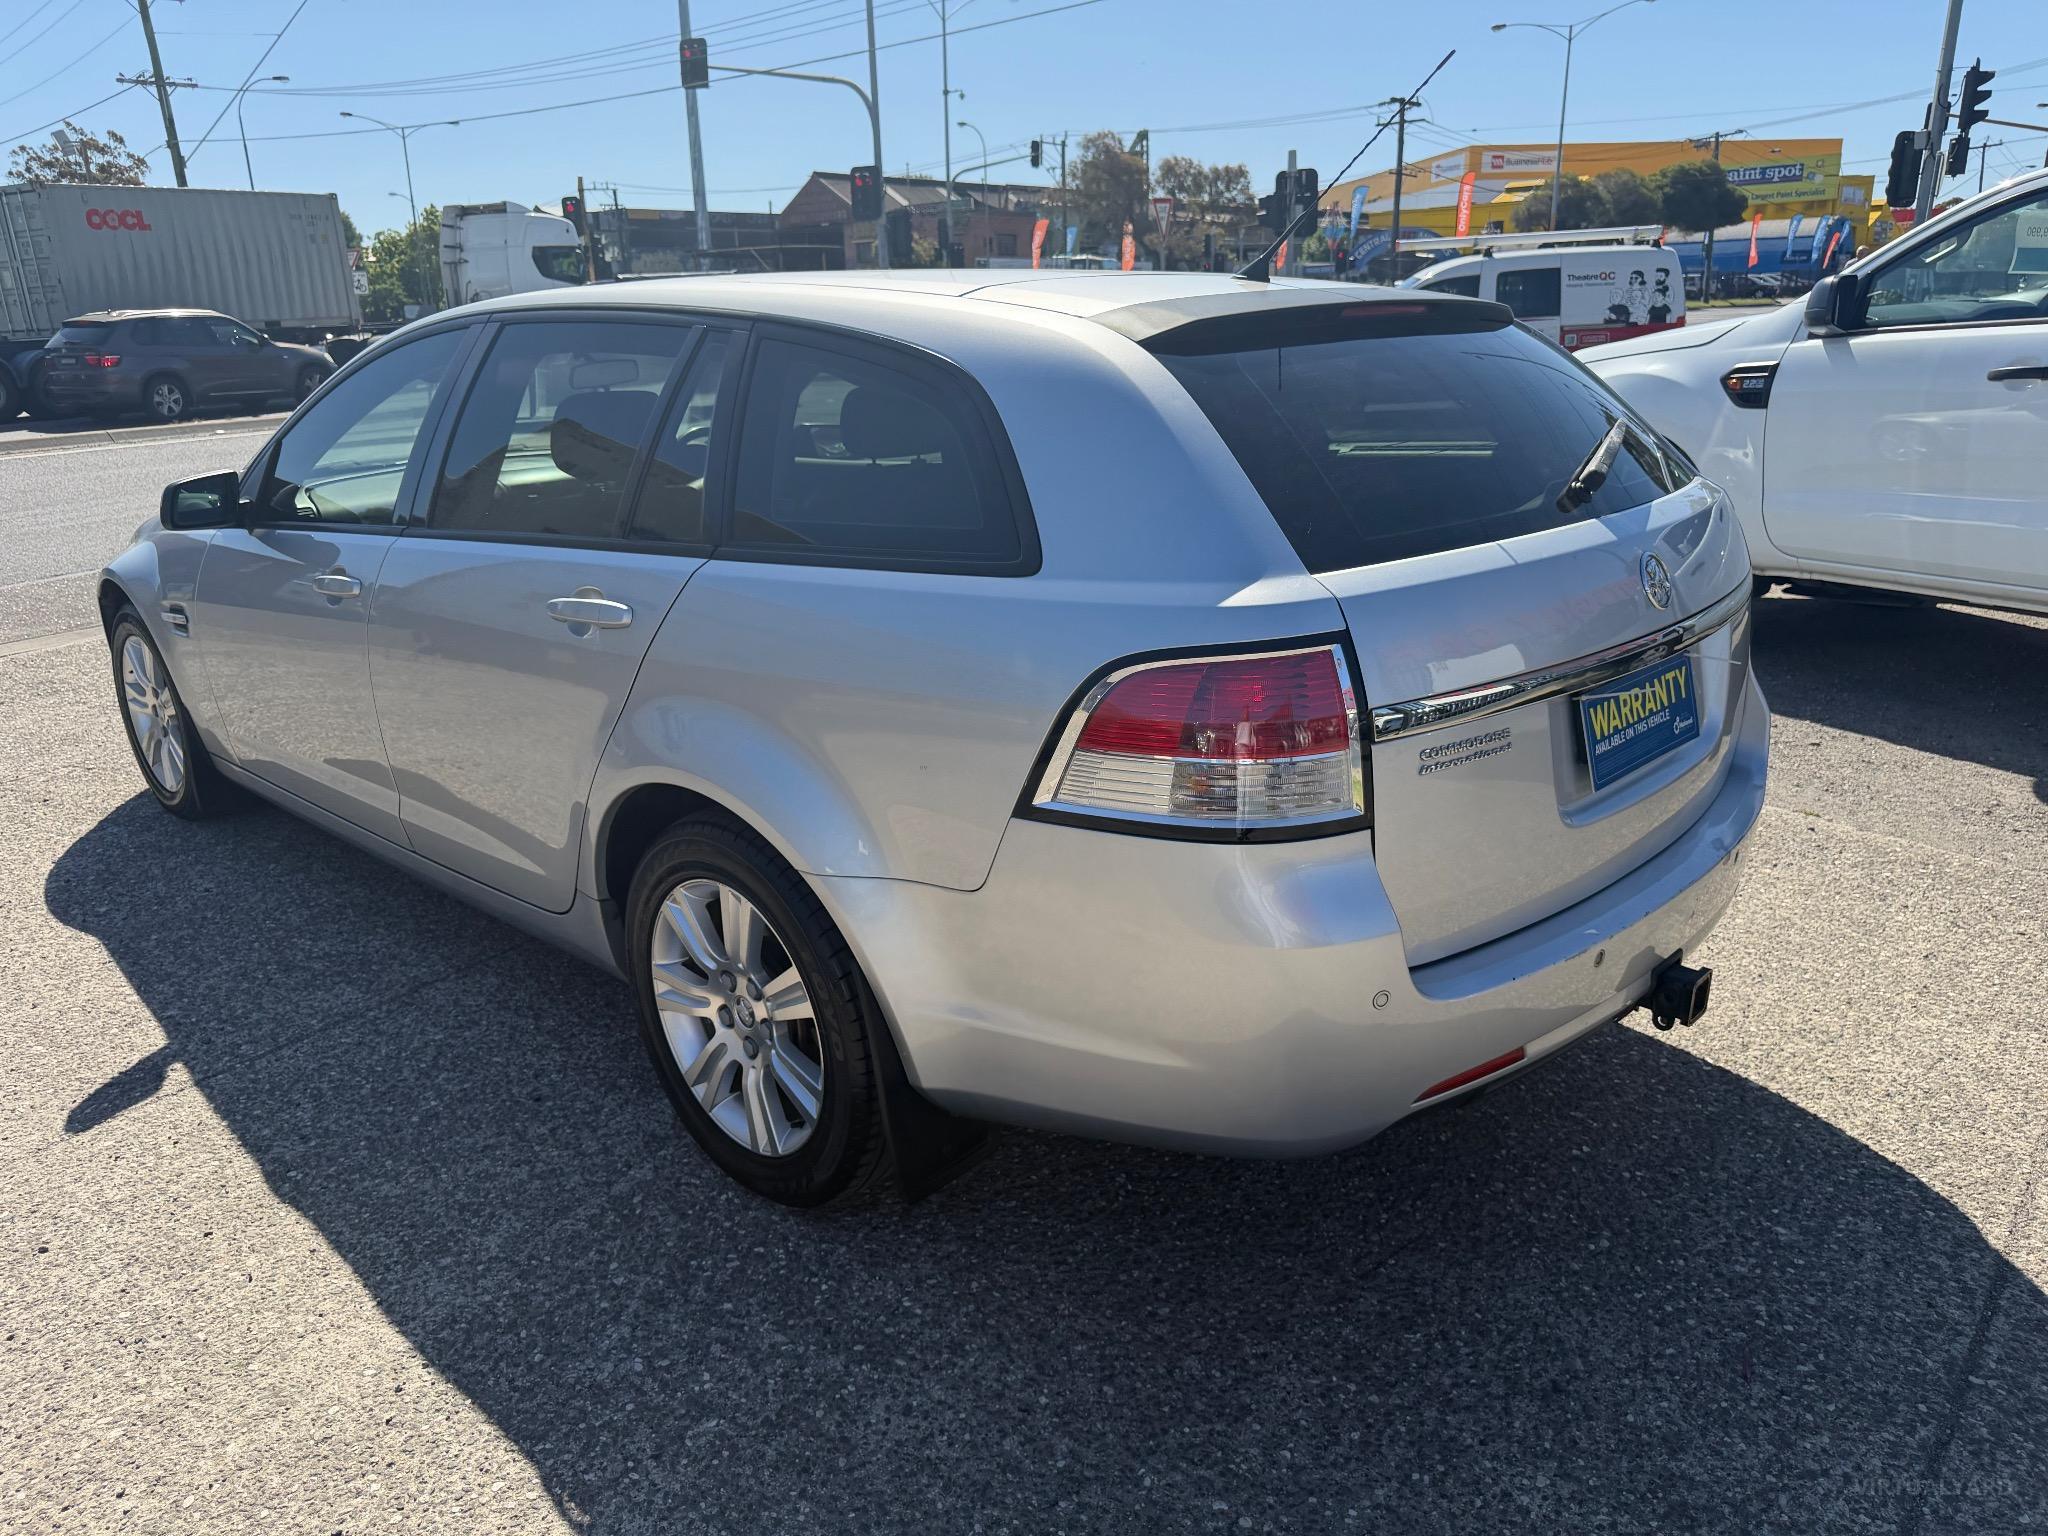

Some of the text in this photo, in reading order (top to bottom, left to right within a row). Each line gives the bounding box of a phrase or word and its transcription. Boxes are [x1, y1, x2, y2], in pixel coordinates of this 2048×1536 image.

[1727, 163, 1802, 182] aint spot
[1776, 190, 1793, 199] Paint
[85, 208, 152, 231] OOCL
[1589, 665, 1686, 741] WARRANTY
[1420, 727, 1512, 761] COMMODORE
[1595, 709, 1671, 756] AVAILABLE ON THIS VEHICLE
